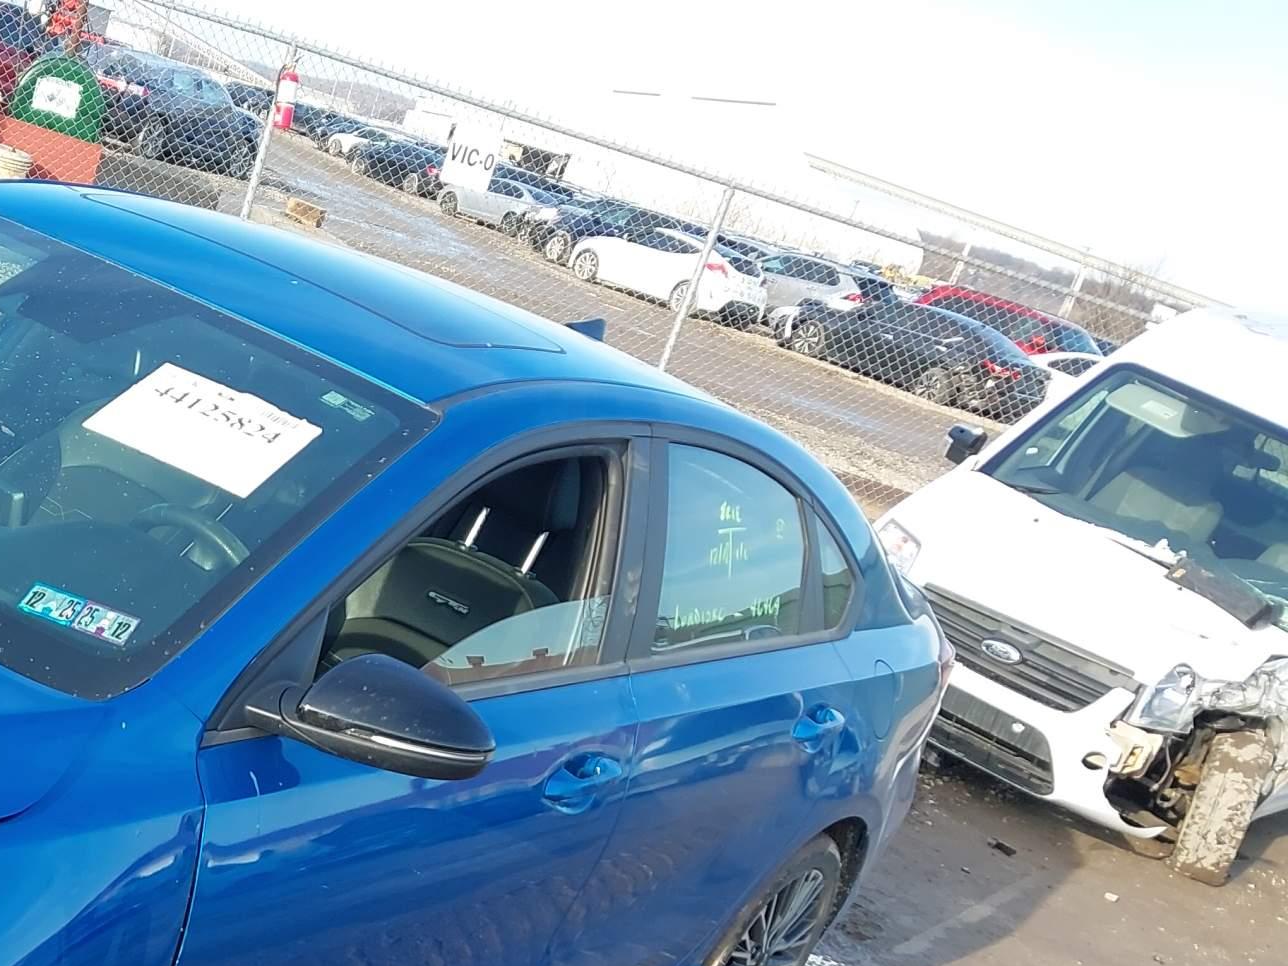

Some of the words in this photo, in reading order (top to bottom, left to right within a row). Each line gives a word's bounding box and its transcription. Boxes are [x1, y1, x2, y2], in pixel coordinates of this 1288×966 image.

[155, 387, 281, 444] 44125824
[25, 590, 46, 609] 12
[59, 599, 81, 620] 25
[78, 606, 99, 627] 25
[111, 620, 132, 640] 12
